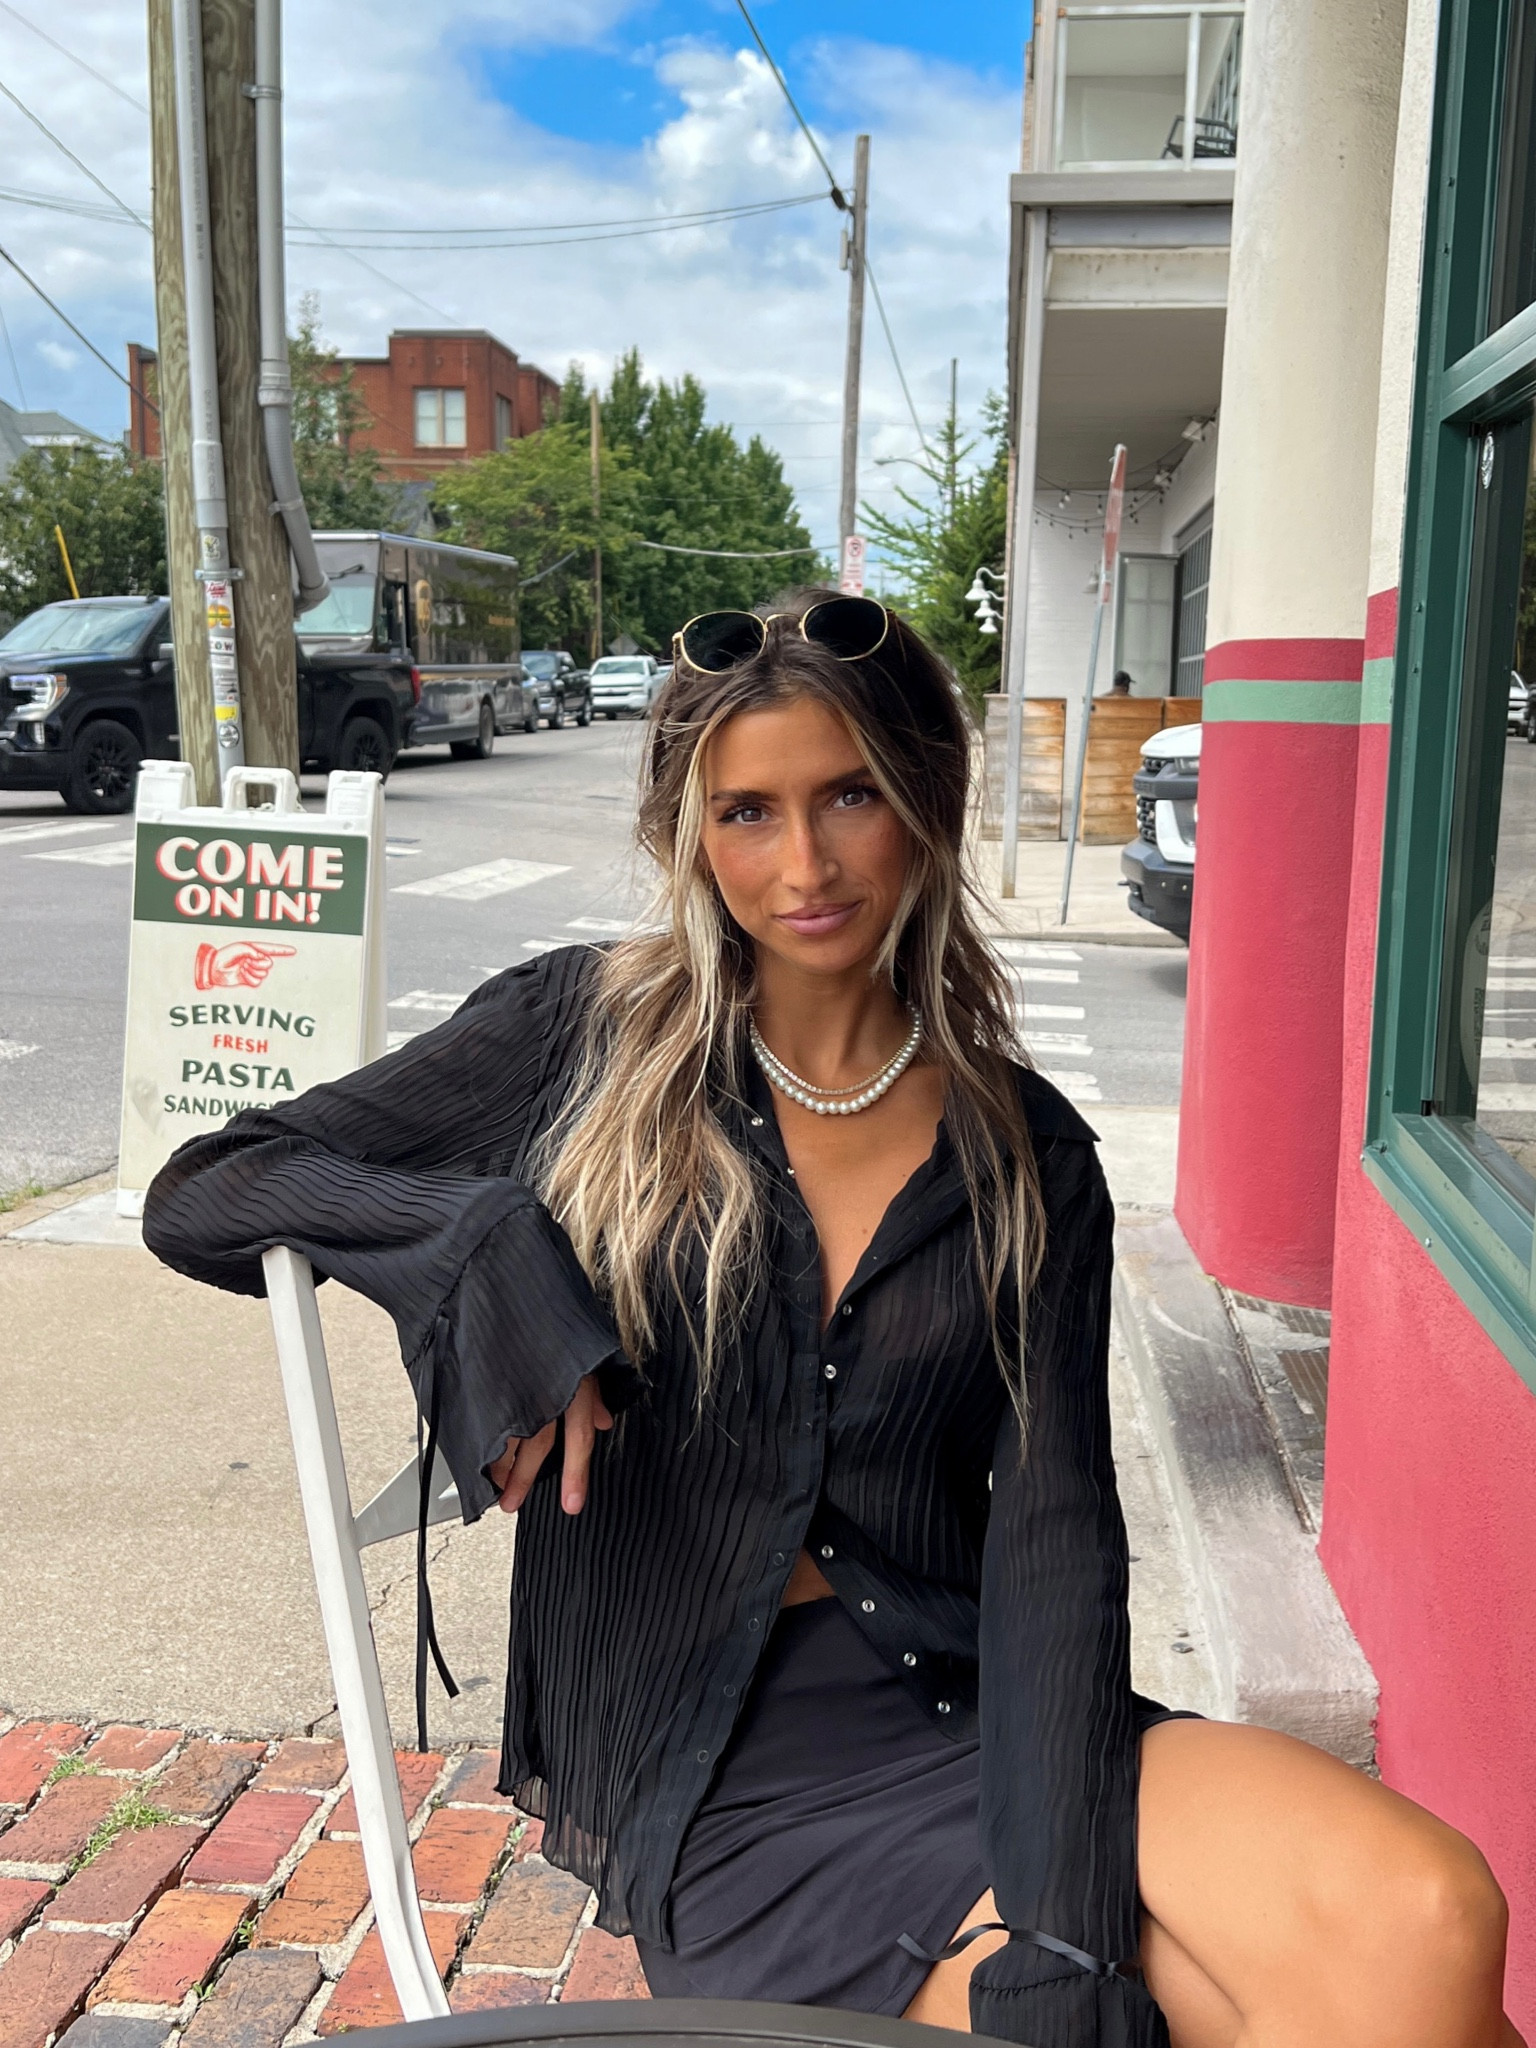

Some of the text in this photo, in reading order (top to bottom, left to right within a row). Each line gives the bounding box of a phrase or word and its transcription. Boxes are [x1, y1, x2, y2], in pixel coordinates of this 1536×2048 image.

[155, 836, 345, 890] COME
[175, 884, 322, 925] ON IN!
[169, 1004, 317, 1037] SERVING
[212, 1033, 270, 1054] FRESH
[181, 1059, 296, 1092] PASTA
